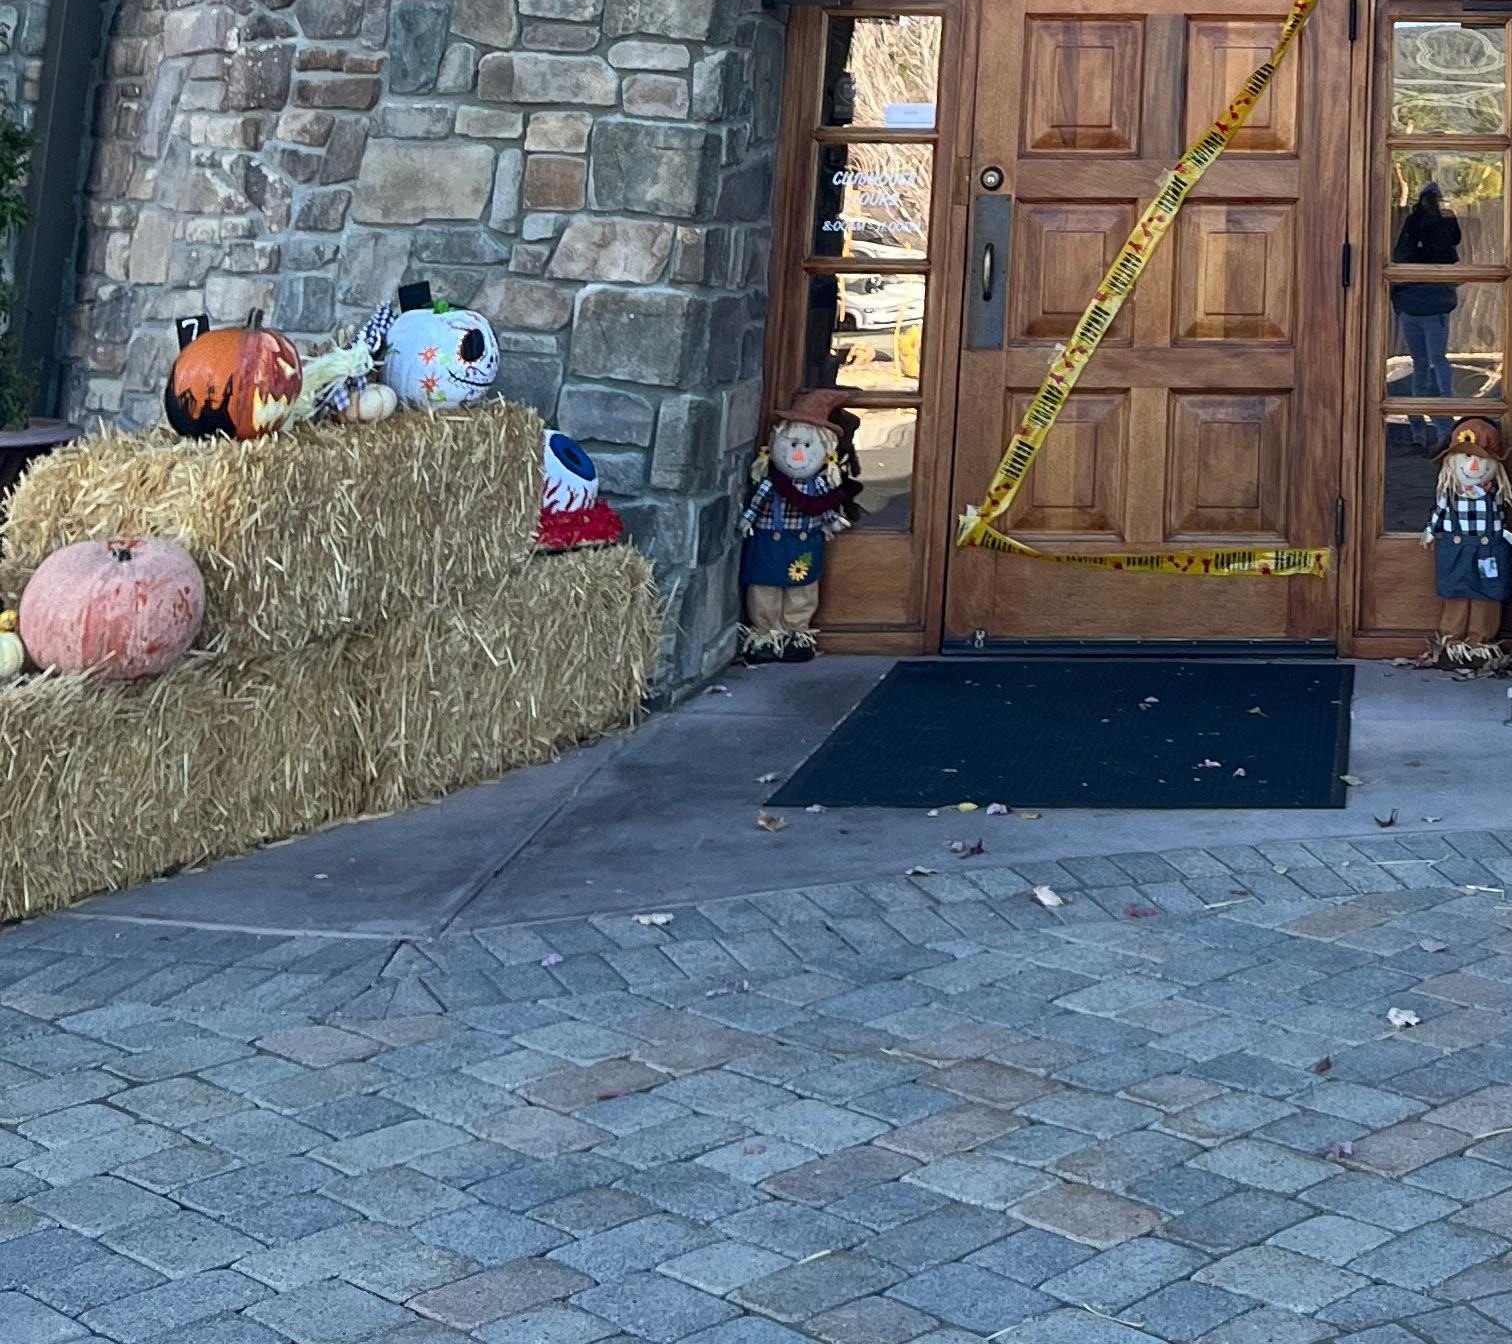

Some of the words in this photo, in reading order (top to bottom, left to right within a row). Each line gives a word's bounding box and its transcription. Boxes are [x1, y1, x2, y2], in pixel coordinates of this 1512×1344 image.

[1188, 130, 1226, 169] CAUTION!
[1155, 174, 1188, 214] BEWARE!
[1106, 251, 1143, 296] CAUTION!
[181, 318, 199, 341] 7
[1077, 304, 1111, 345] BEWARE!
[1027, 383, 1063, 428] CAUTION!
[1000, 439, 1035, 482] BEWARE!
